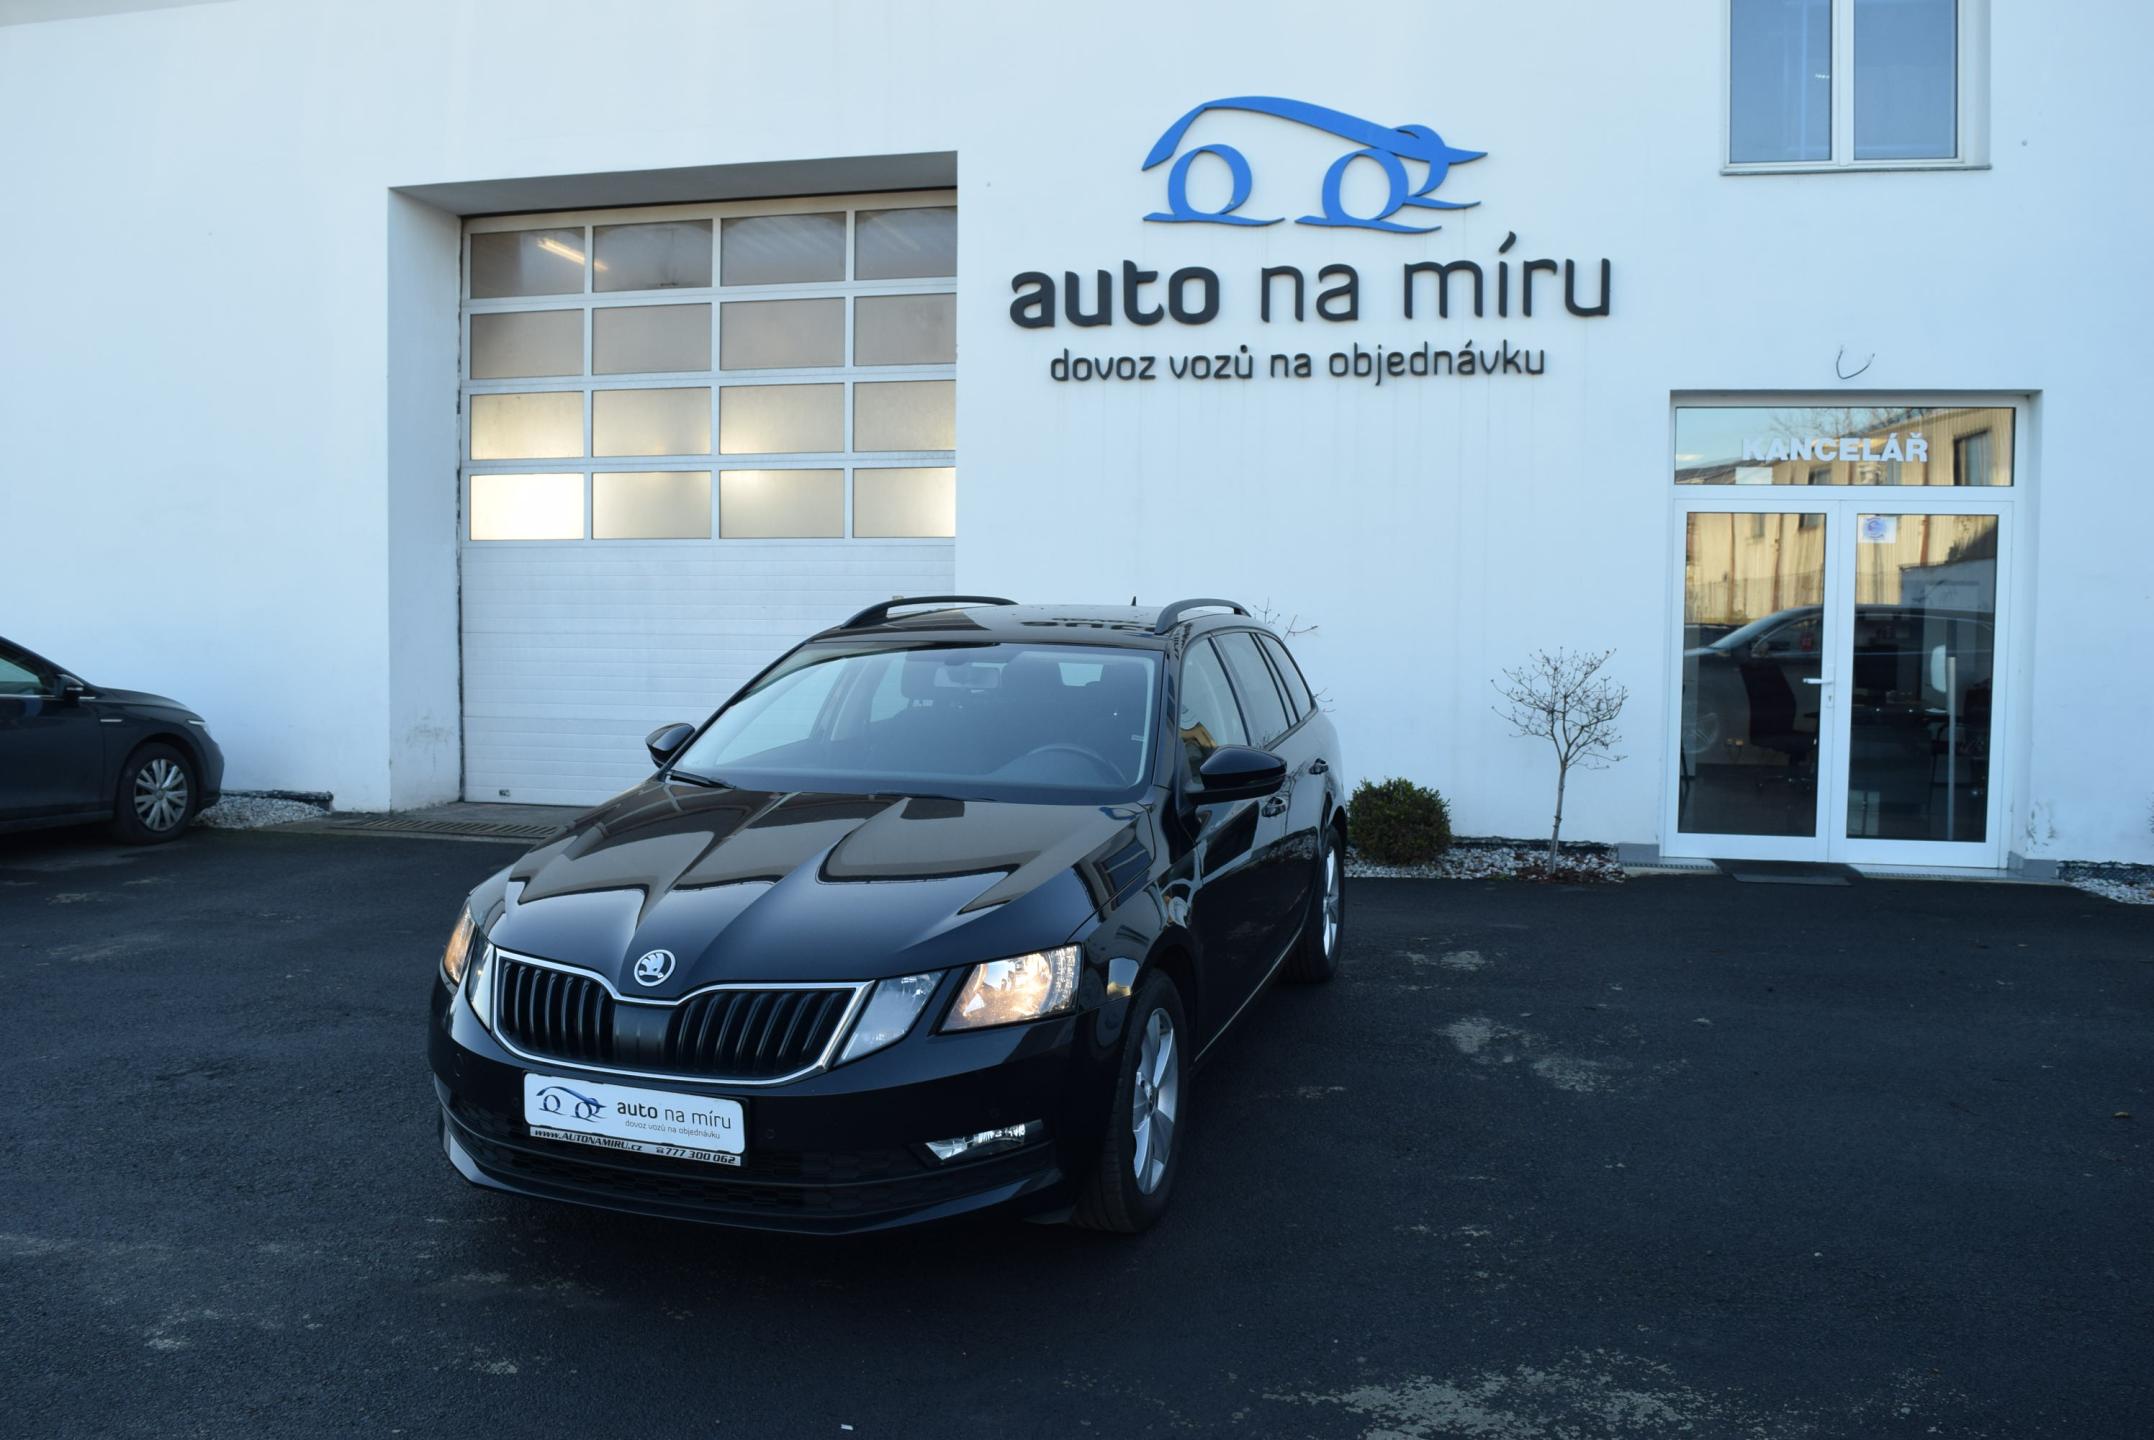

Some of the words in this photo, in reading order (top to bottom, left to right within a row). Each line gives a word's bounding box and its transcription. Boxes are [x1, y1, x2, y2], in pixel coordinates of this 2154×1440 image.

[1010, 259, 1220, 329] auto
[1261, 263, 1360, 323] na
[1404, 231, 1611, 319] míru
[1050, 348, 1157, 383] dovoz
[1169, 344, 1254, 381] vozů
[1270, 352, 1312, 379] na
[1328, 339, 1545, 387] objednávku
[1742, 432, 1929, 462] KANCELÁŘ
[617, 1101, 658, 1119] auto
[665, 1109, 685, 1123] na
[692, 1110, 732, 1129] míru
[625, 1120, 647, 1130] dovoz
[668, 1126, 677, 1134] na
[688, 1151, 712, 1162] 300
[713, 1154, 736, 1165] 062
